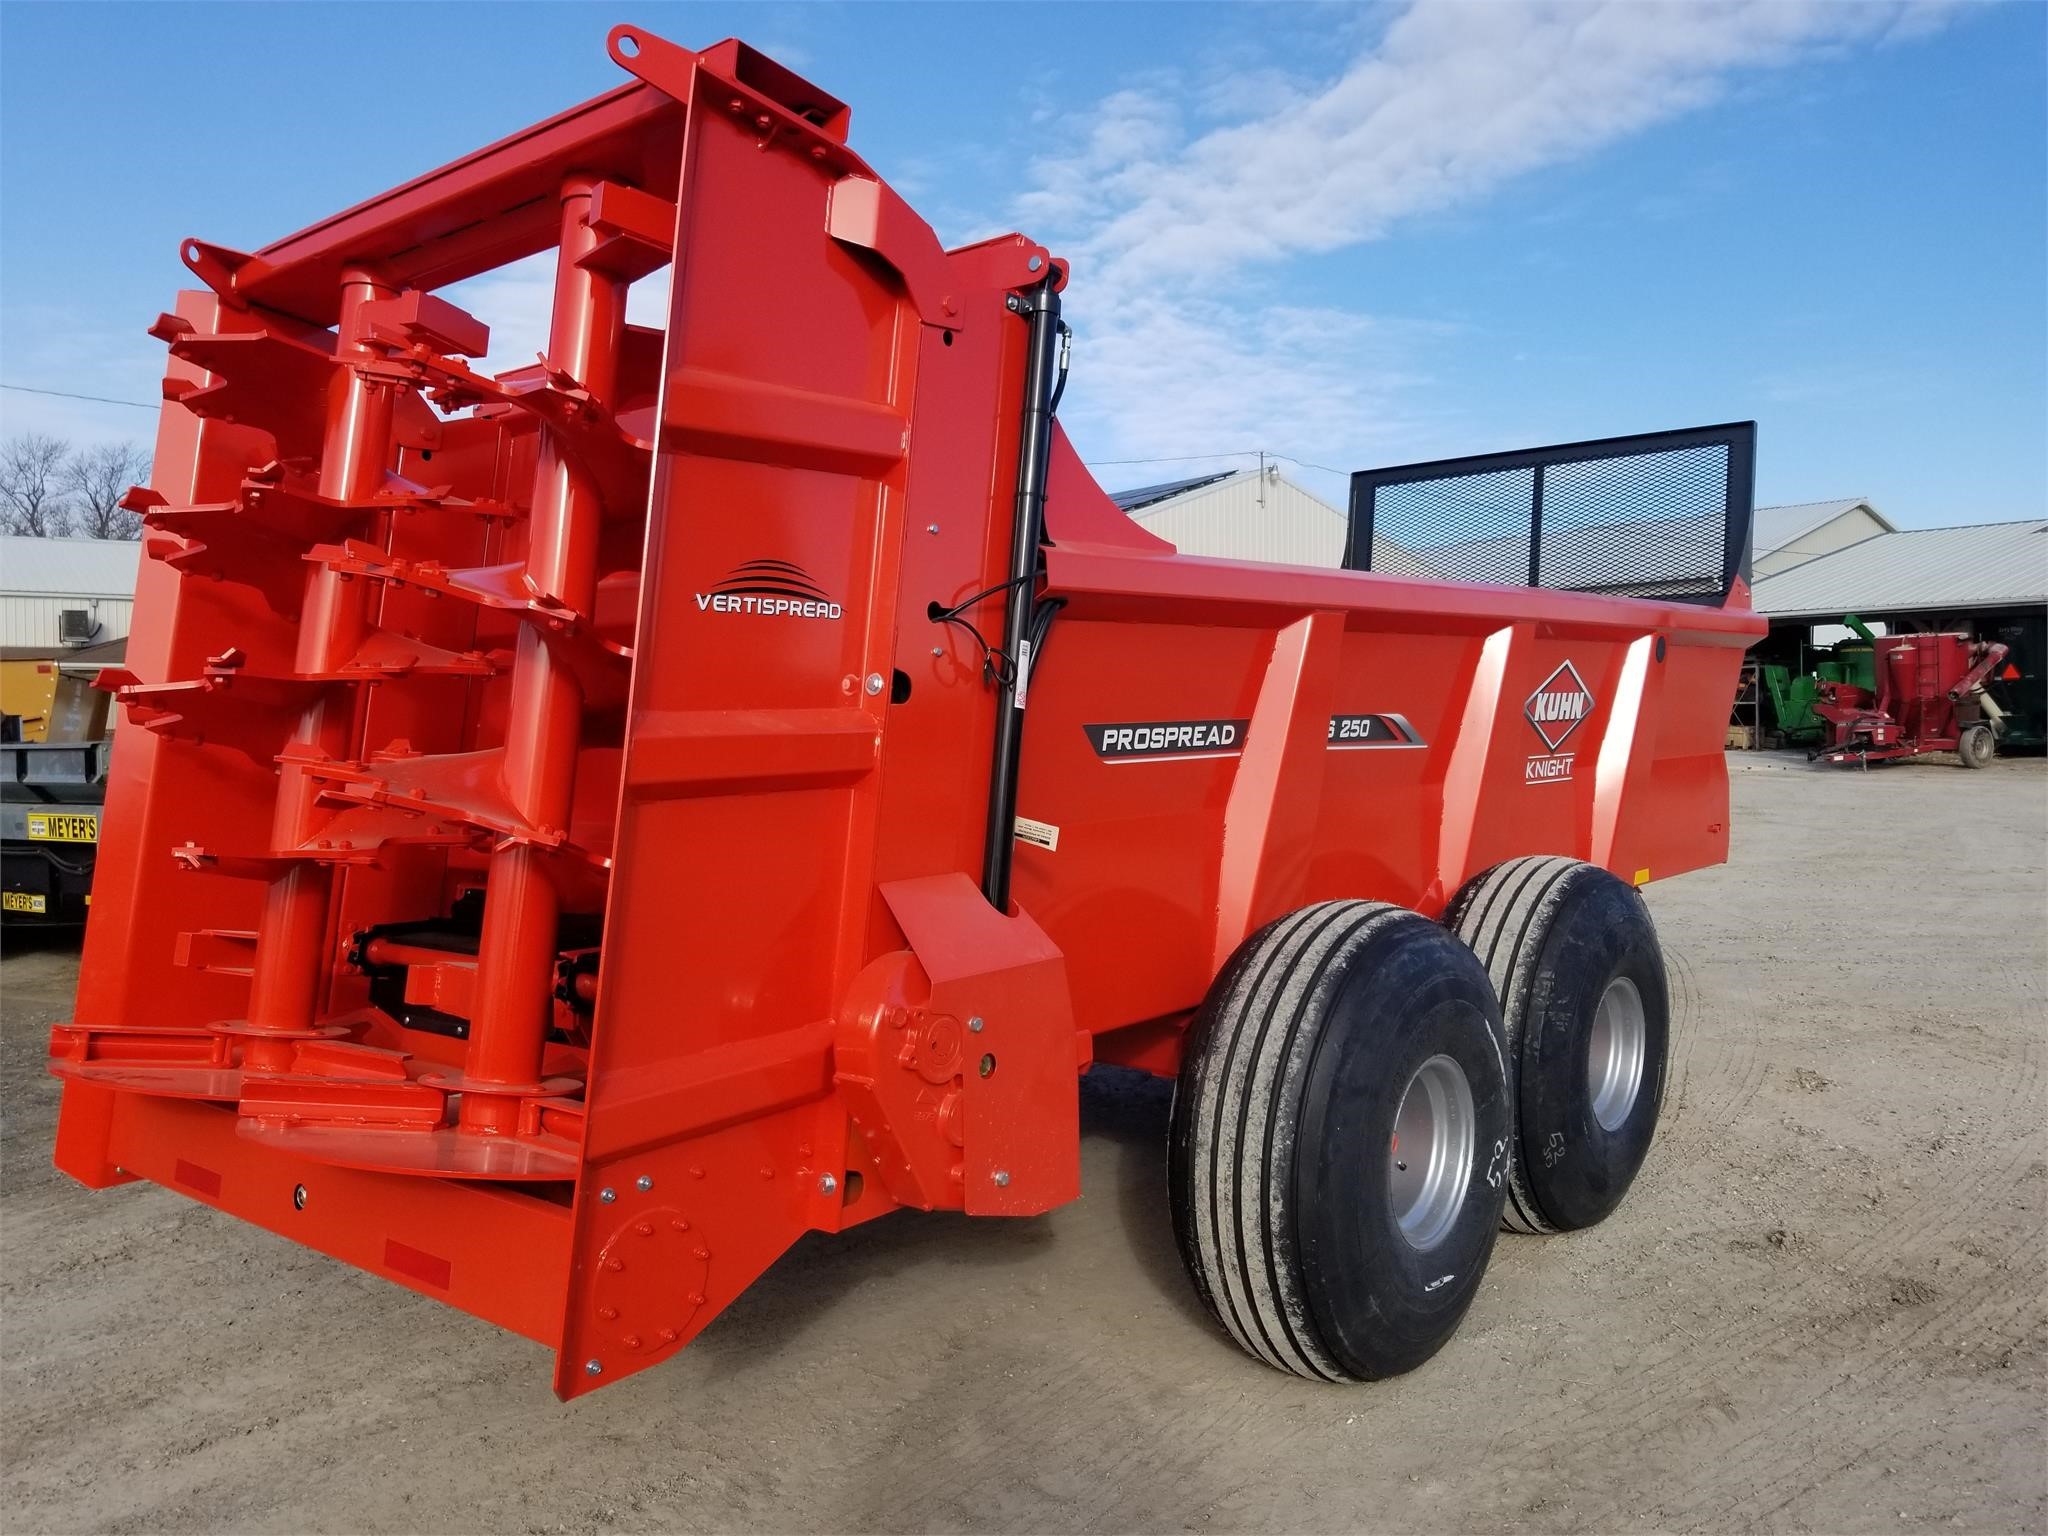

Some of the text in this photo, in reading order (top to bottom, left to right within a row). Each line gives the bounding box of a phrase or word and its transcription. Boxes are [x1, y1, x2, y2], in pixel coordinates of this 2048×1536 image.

[695, 593, 842, 619] VERTISPREAD
[1534, 692, 1585, 721] KUHN
[1102, 724, 1235, 751] PROSPREAD
[1340, 719, 1370, 738] 250
[1525, 758, 1574, 779] KNIGHT
[48, 817, 96, 839] MEYER'S
[4, 893, 33, 910] MEYER'S
